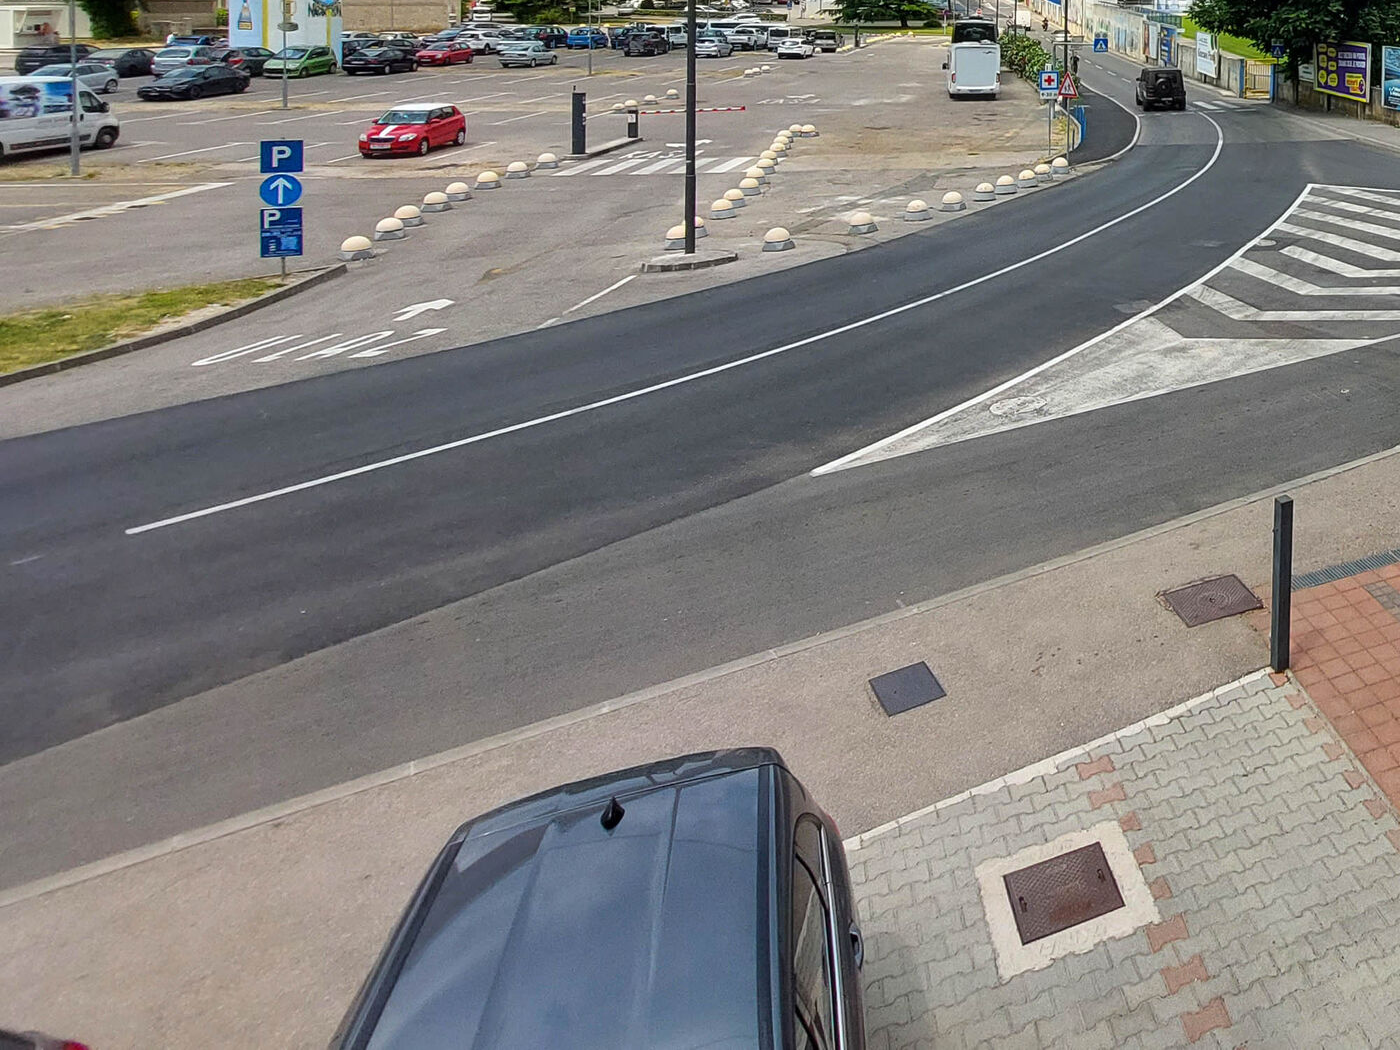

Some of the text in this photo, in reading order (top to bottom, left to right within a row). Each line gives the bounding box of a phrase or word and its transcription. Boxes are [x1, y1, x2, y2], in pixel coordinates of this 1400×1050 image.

[272, 146, 292, 167] P
[263, 210, 281, 228] P
[191, 328, 449, 367] ULAZ
